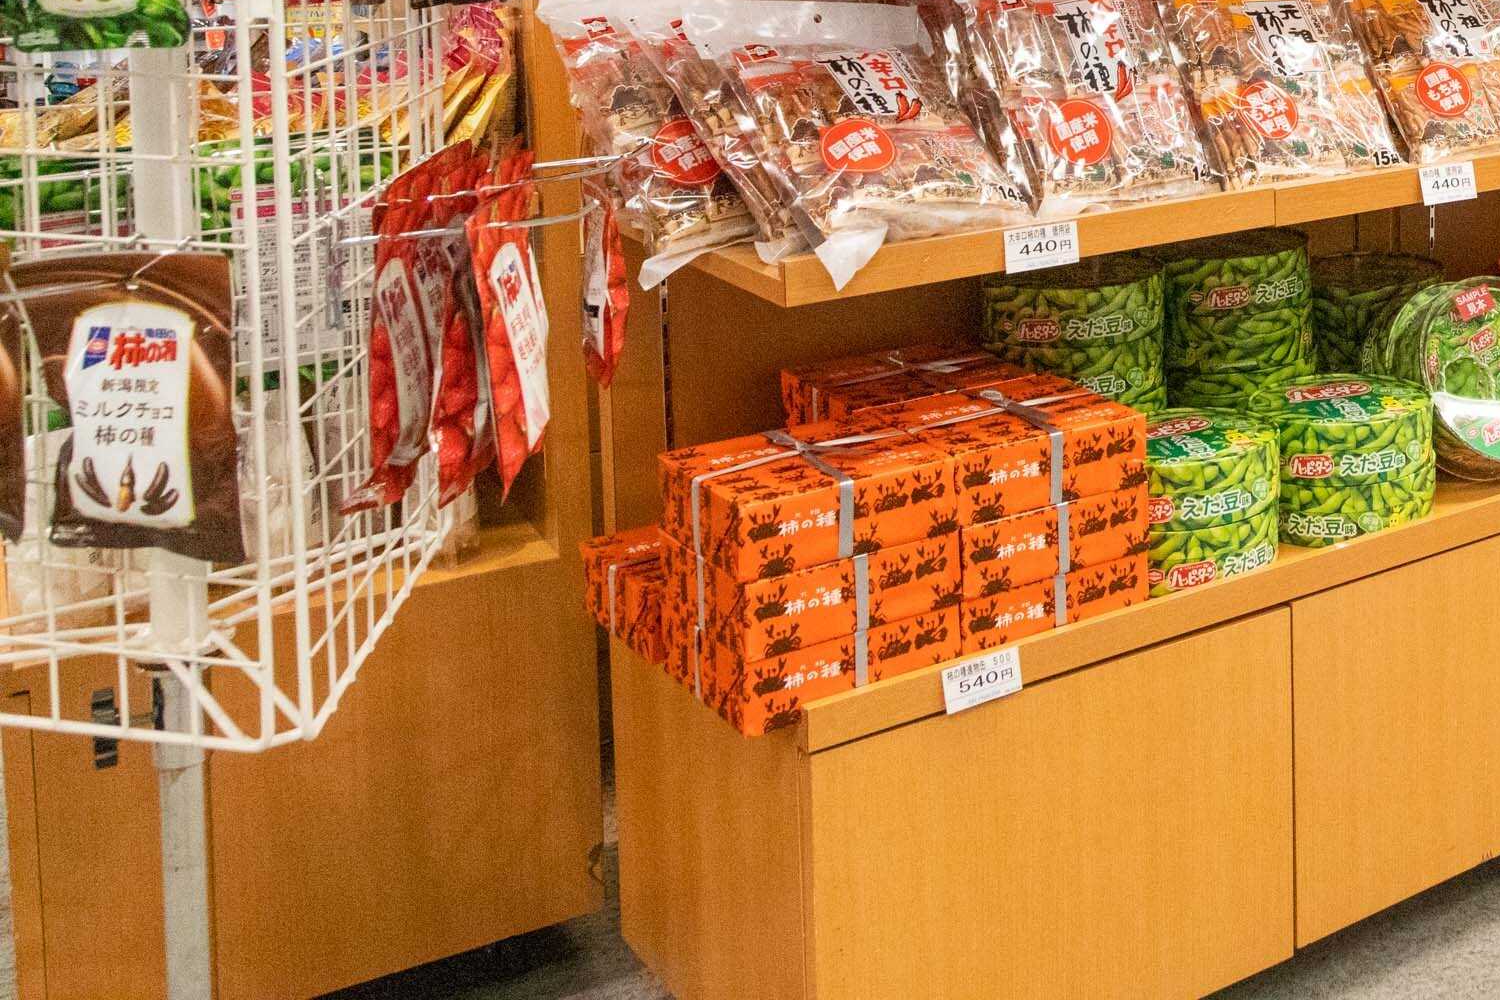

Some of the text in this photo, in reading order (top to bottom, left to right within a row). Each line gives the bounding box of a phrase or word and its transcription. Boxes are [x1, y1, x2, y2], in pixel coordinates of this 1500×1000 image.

[1054, 7, 1116, 92] 柿の種
[817, 54, 896, 116] 柿の種
[1424, 67, 1451, 87] 国産
[1426, 79, 1464, 102] もち米
[1438, 93, 1465, 112] 使用
[1056, 111, 1099, 143] 国産米
[1068, 129, 1101, 152] 使用
[1431, 177, 1472, 191] 440円
[1019, 237, 1073, 257] 440円
[1455, 287, 1488, 306] SAMPLE
[1466, 300, 1488, 315] 見本
[1067, 315, 1133, 339] えだ豆味
[109, 333, 177, 370] 柿の種
[101, 378, 159, 394] 新潟限定
[75, 400, 174, 420] ミルクチョコ
[94, 425, 154, 446] 柿の種
[989, 461, 1041, 486] 柿の種
[1340, 451, 1406, 476] えだ豆味
[1182, 489, 1252, 520] えだ豆味
[779, 510, 837, 537] 柿の種
[1288, 513, 1357, 538] えだ豆味
[998, 534, 1046, 560] 柿の種
[784, 588, 843, 616] 柿の種
[995, 603, 1045, 629] 柿の種
[784, 661, 841, 691] 柿の種
[958, 667, 1013, 694] 540円
